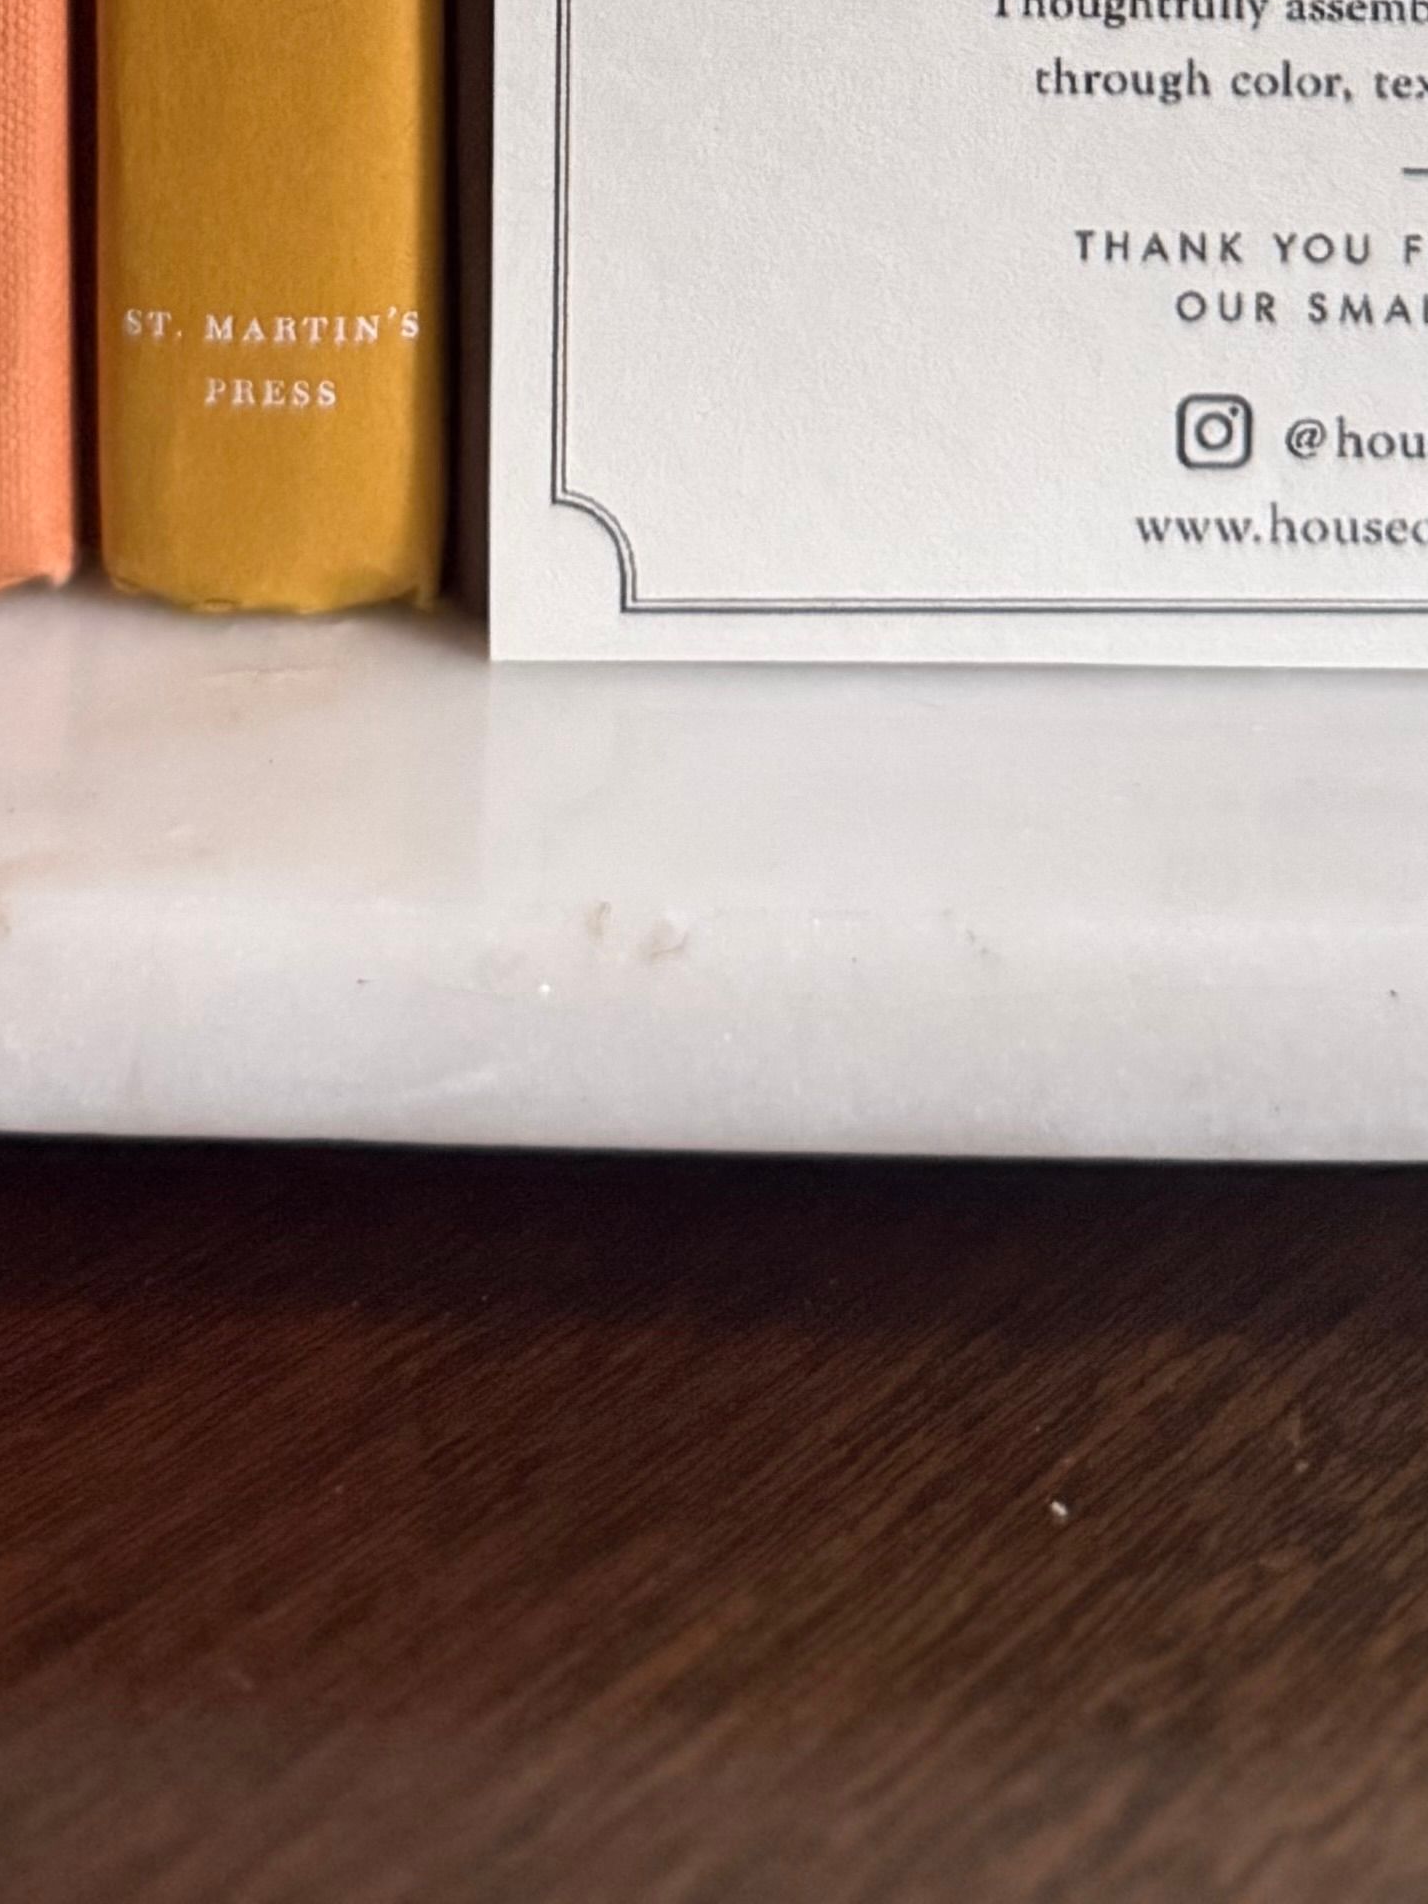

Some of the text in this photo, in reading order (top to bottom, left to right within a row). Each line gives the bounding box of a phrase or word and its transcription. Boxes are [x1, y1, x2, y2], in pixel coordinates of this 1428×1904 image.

[1035, 56, 1212, 105] through
[1230, 58, 1352, 102] color,
[1074, 229, 1243, 265] THANK
[1272, 232, 1372, 267] YOU
[123, 305, 421, 344] ST. MARTIN'S
[1174, 290, 1277, 325] OUR
[203, 378, 339, 410] PRESS
